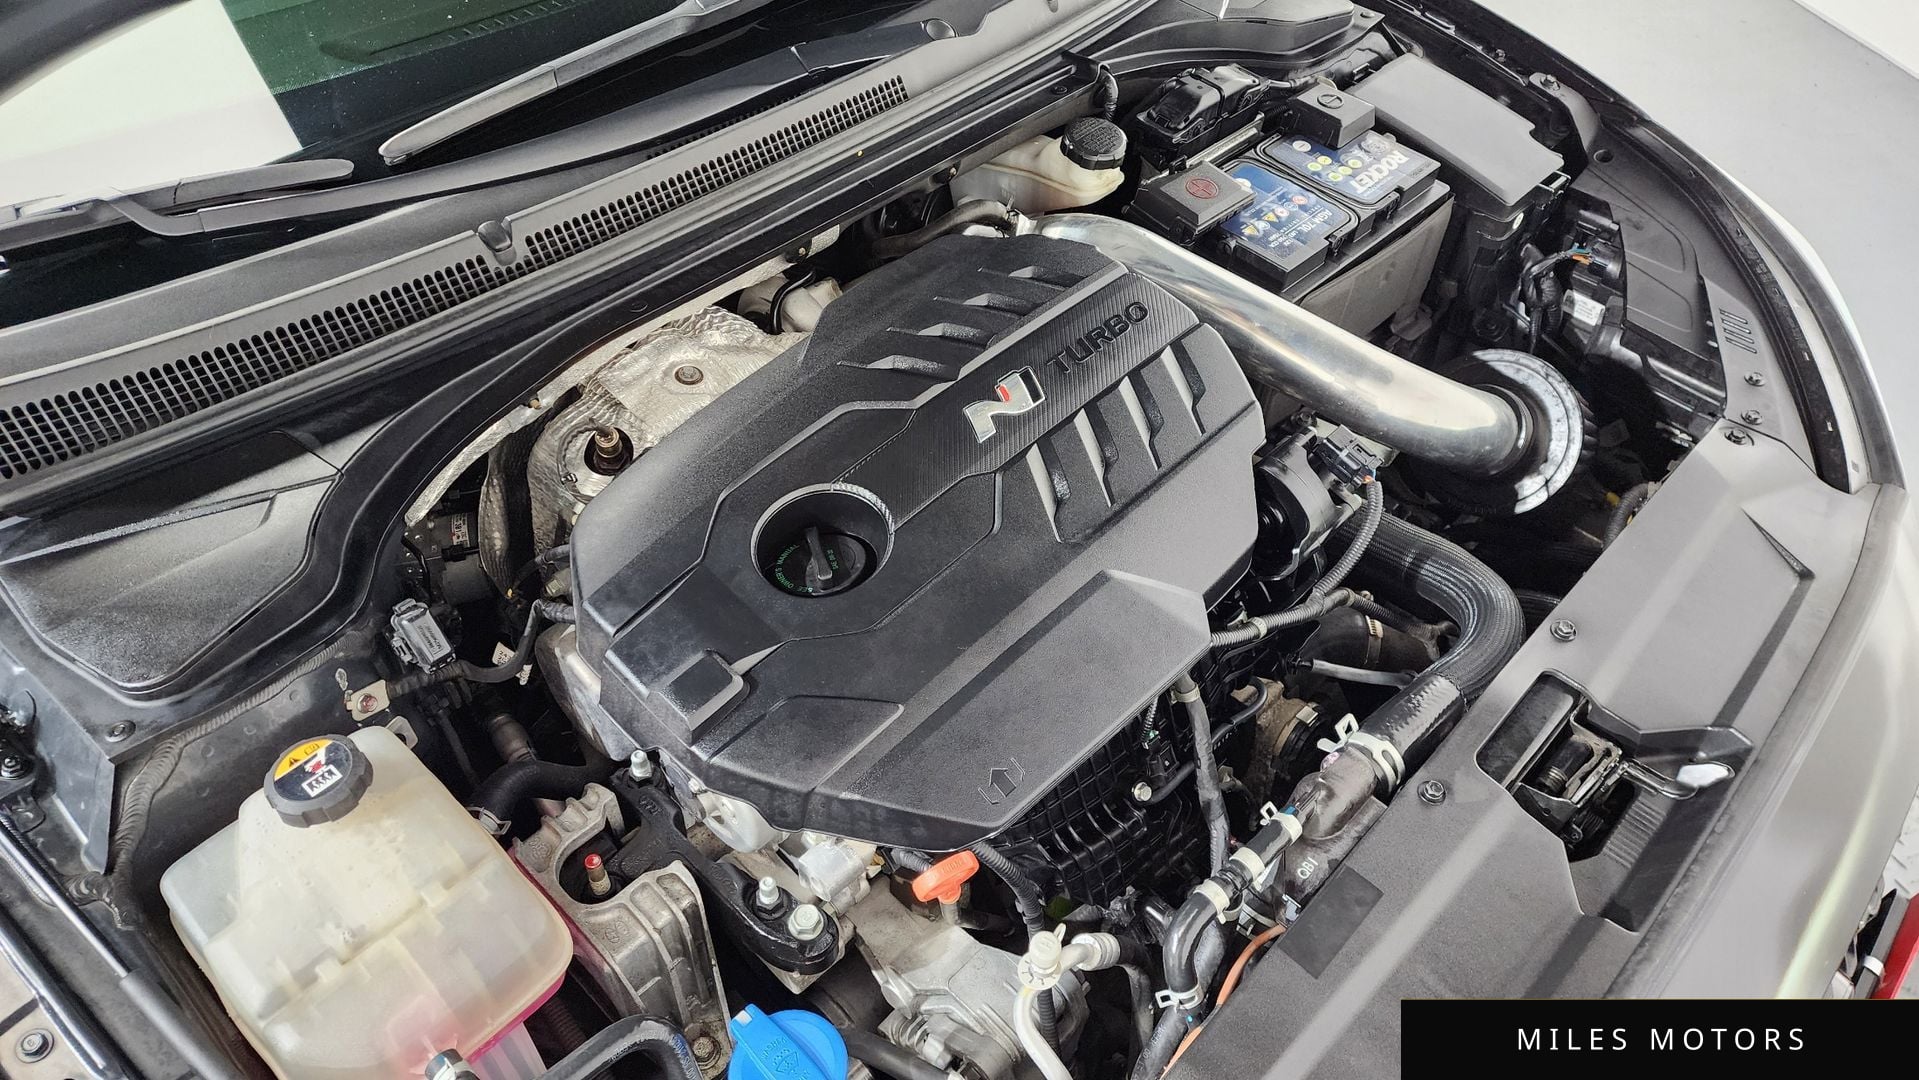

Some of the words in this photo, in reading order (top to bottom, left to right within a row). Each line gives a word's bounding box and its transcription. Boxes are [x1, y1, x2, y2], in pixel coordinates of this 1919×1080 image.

[1350, 150, 1410, 194] ROCKET
[1046, 301, 1149, 374] TURBO
[776, 544, 801, 565] MANUAL
